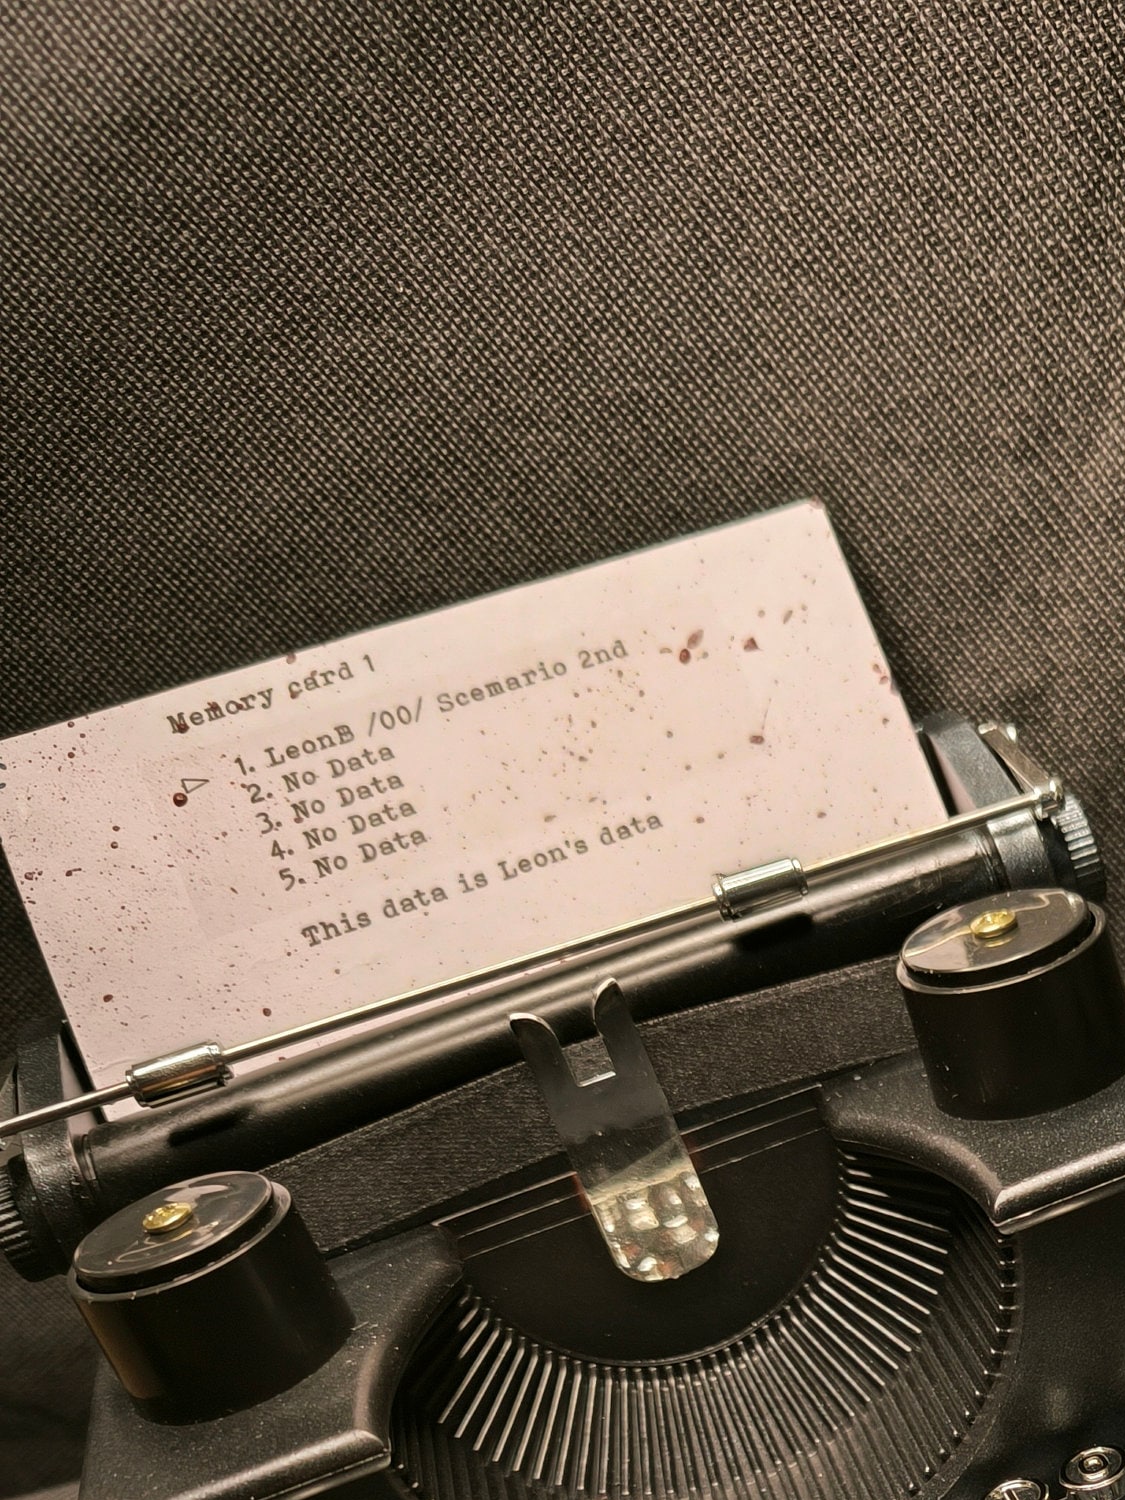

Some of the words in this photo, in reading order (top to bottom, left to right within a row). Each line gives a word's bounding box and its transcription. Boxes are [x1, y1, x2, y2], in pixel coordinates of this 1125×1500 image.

[166, 688, 274, 734] Memory
[287, 662, 354, 697] card
[363, 654, 375, 672] 1
[234, 757, 256, 776] 1.
[264, 724, 355, 768] LeonB
[437, 661, 567, 713] Scemario
[577, 640, 629, 670] 2nd
[247, 783, 273, 804] 2.
[281, 770, 316, 793] No
[327, 746, 396, 778] Data
[255, 812, 283, 834] 3.
[291, 799, 326, 820] No
[336, 775, 404, 808] Data
[270, 839, 295, 860] 4.
[302, 827, 337, 850] No
[347, 802, 418, 835] Data
[278, 867, 306, 892] 5.
[313, 855, 348, 878] No
[358, 830, 428, 863] Data
[301, 908, 372, 948] This
[382, 886, 449, 921] data
[457, 870, 489, 894] is
[497, 839, 589, 881] Leon's
[599, 812, 663, 846] data
